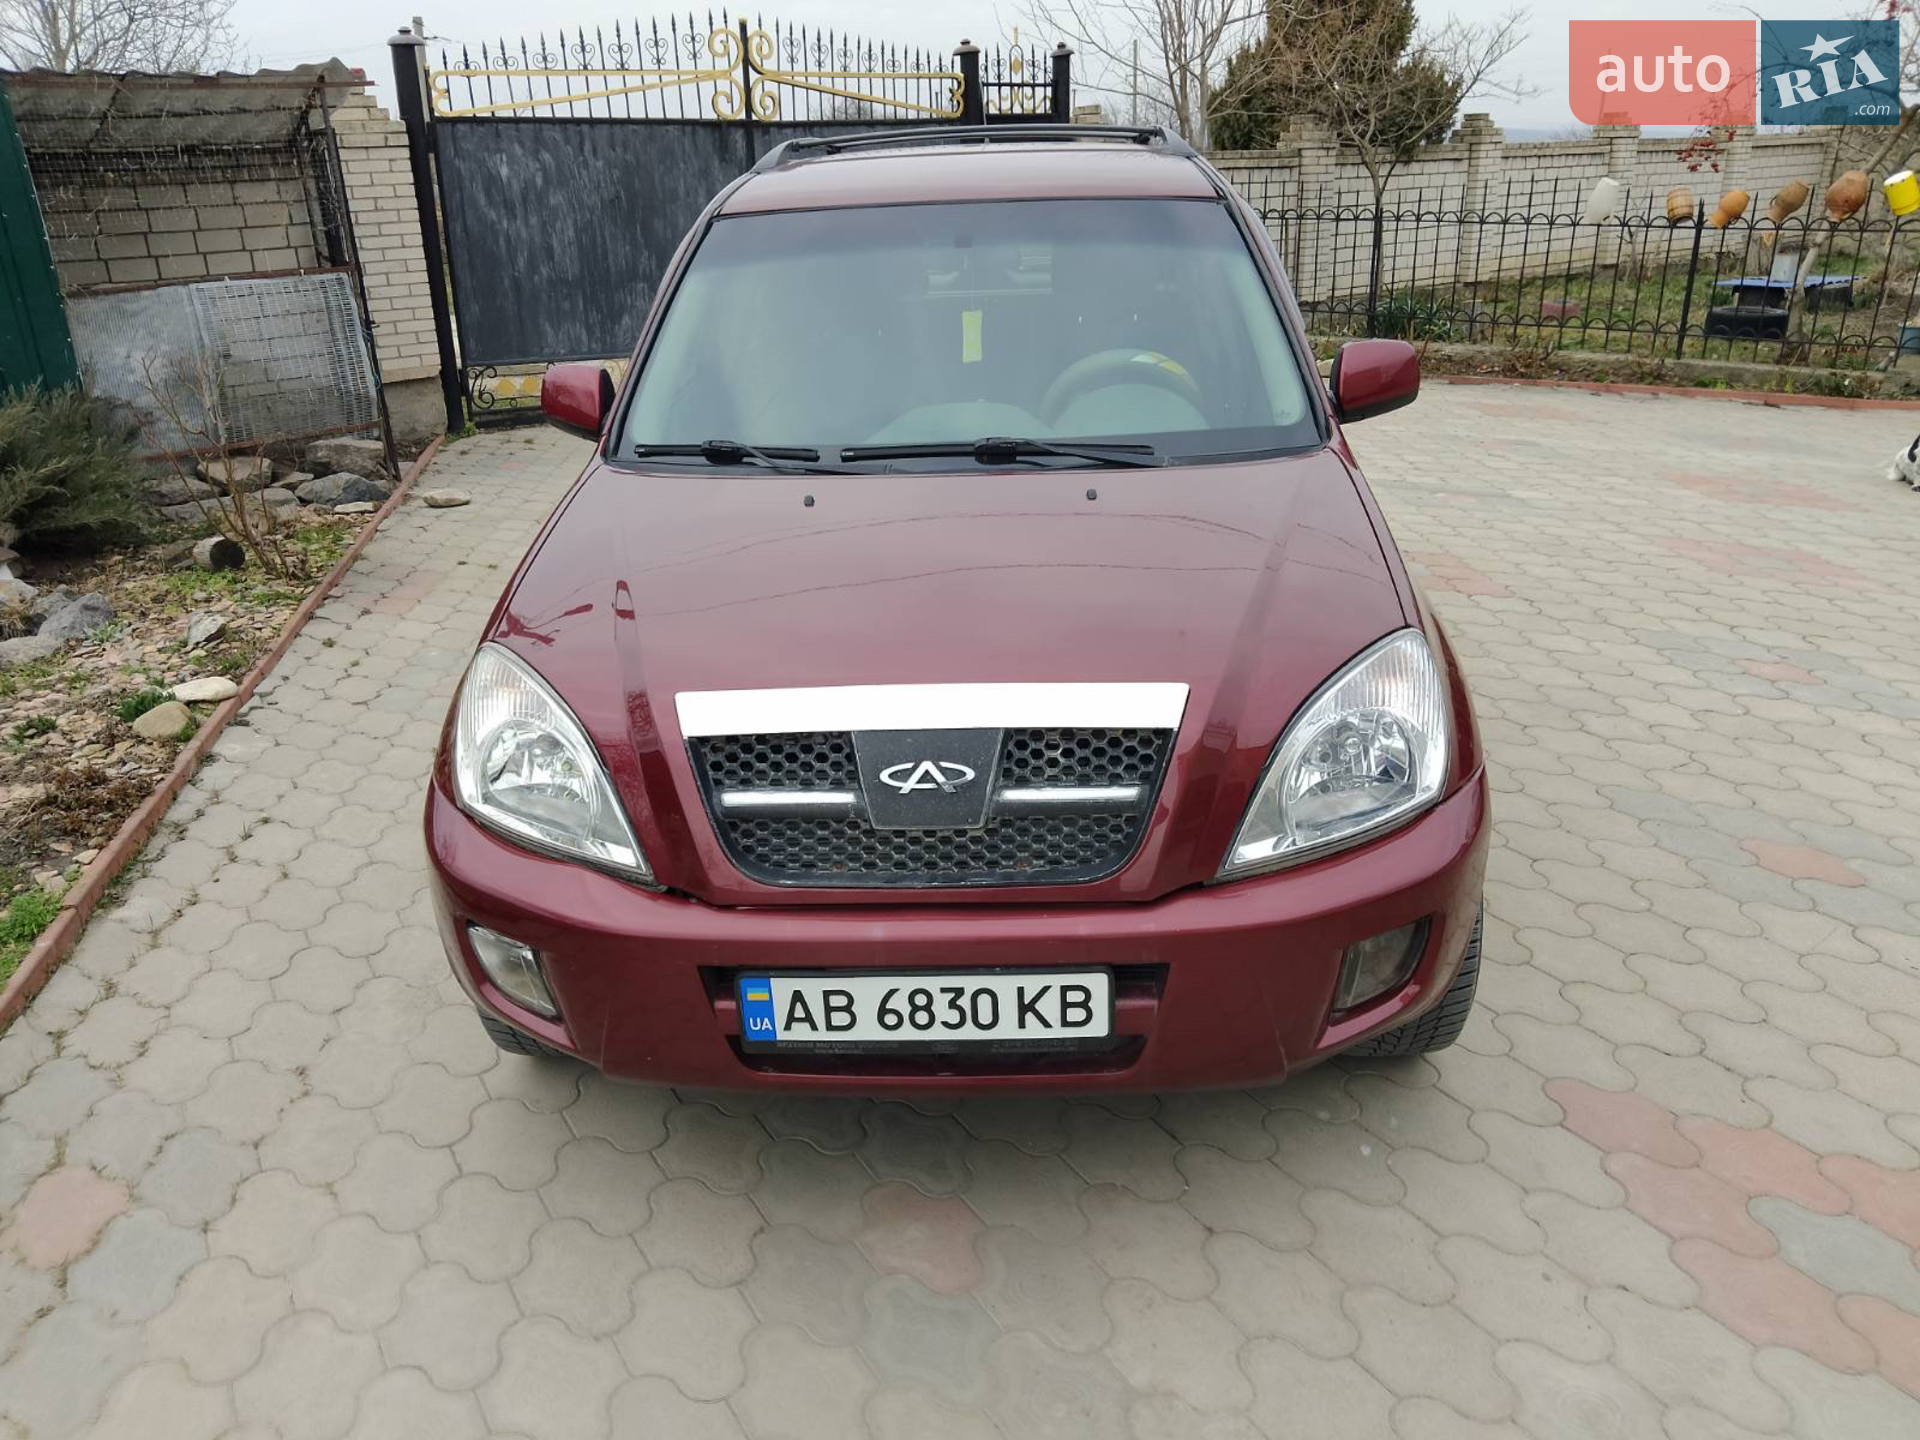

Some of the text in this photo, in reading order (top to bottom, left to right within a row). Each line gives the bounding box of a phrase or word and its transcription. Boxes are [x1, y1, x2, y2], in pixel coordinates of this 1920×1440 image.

[783, 984, 1094, 1032] AB 6830 KB
[749, 1017, 773, 1031] UA
